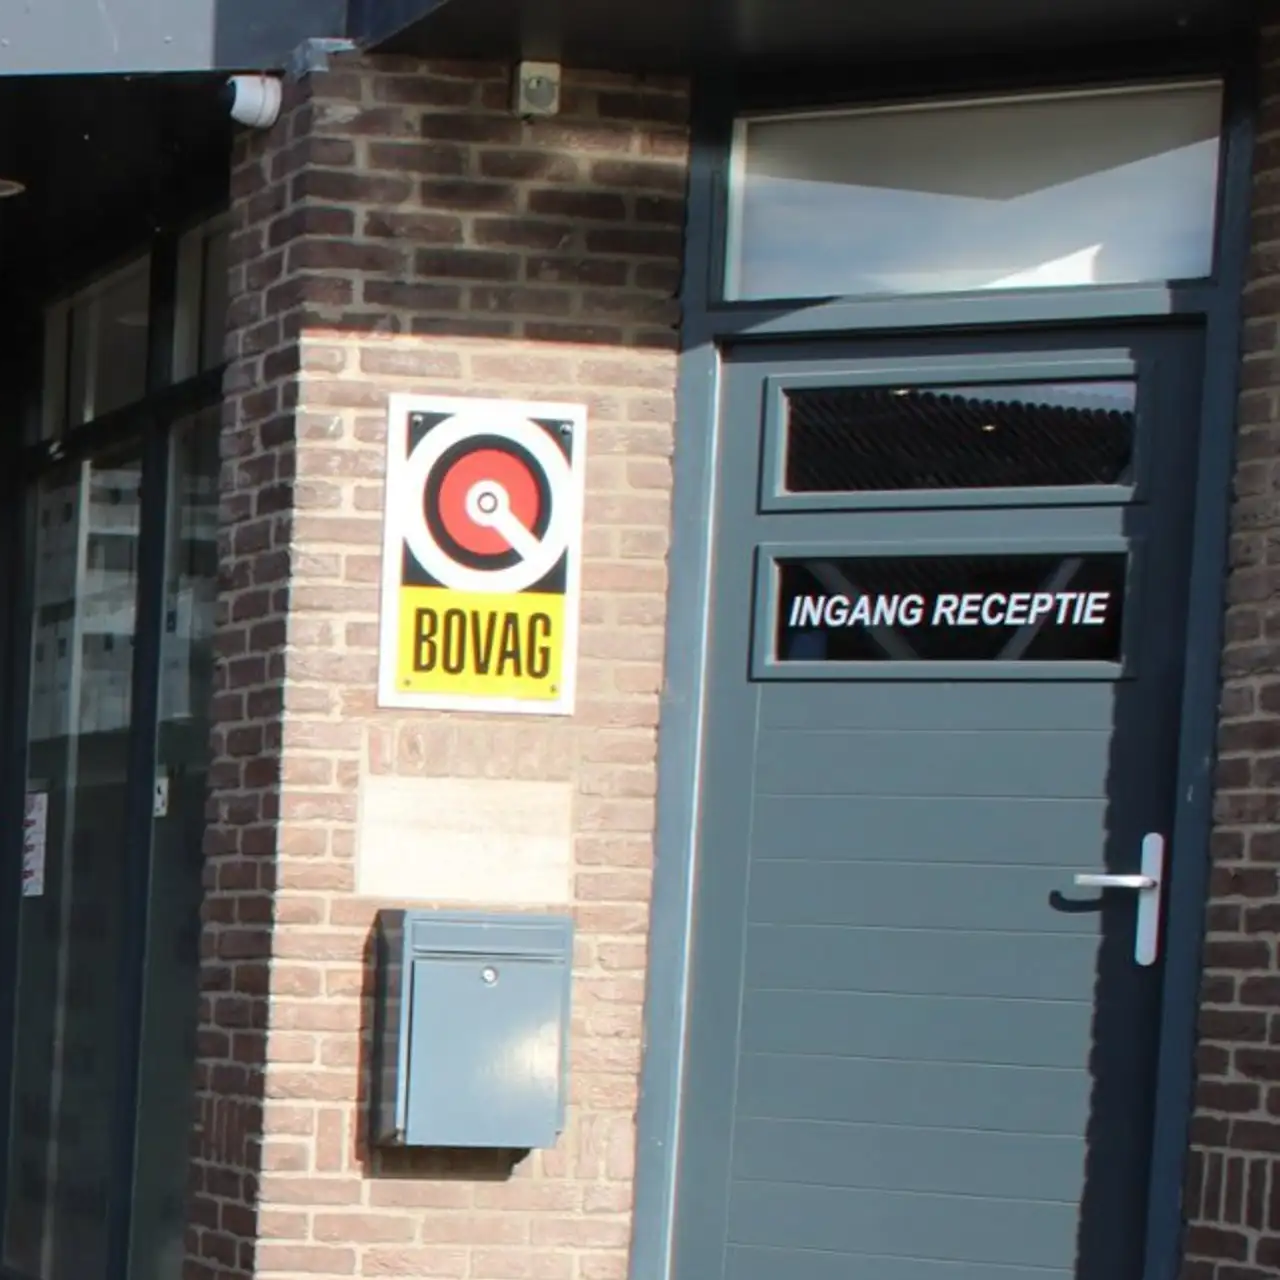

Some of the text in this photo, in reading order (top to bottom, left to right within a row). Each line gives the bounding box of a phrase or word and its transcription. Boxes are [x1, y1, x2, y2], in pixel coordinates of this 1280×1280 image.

[788, 592, 1111, 627] INGANG RECEPTIE
[412, 607, 552, 680] BOVAG
